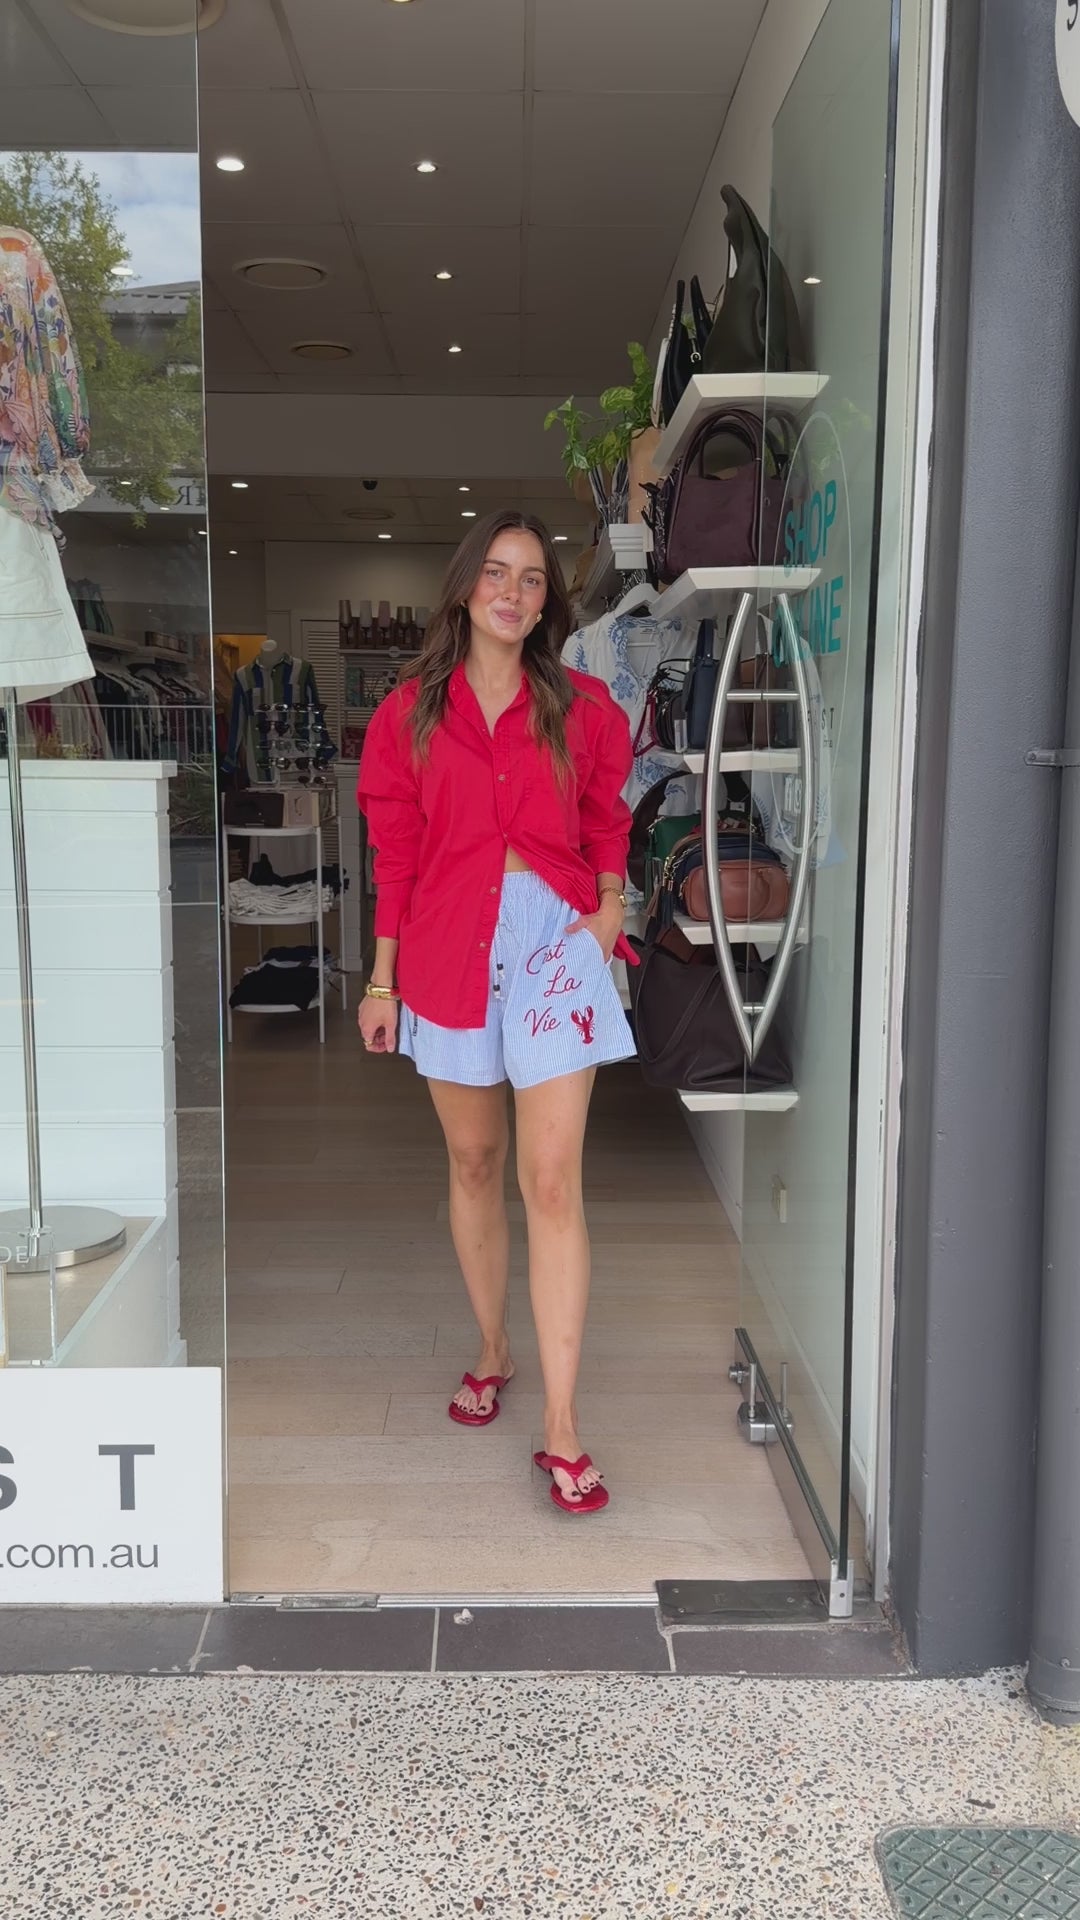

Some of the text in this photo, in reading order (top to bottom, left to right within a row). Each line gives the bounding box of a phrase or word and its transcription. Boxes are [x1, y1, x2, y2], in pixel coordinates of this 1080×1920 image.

[783, 479, 837, 578] SHOP
[543, 965, 582, 997] La
[524, 1006, 561, 1037] Vie
[0, 1544, 159, 1568] .com.au
